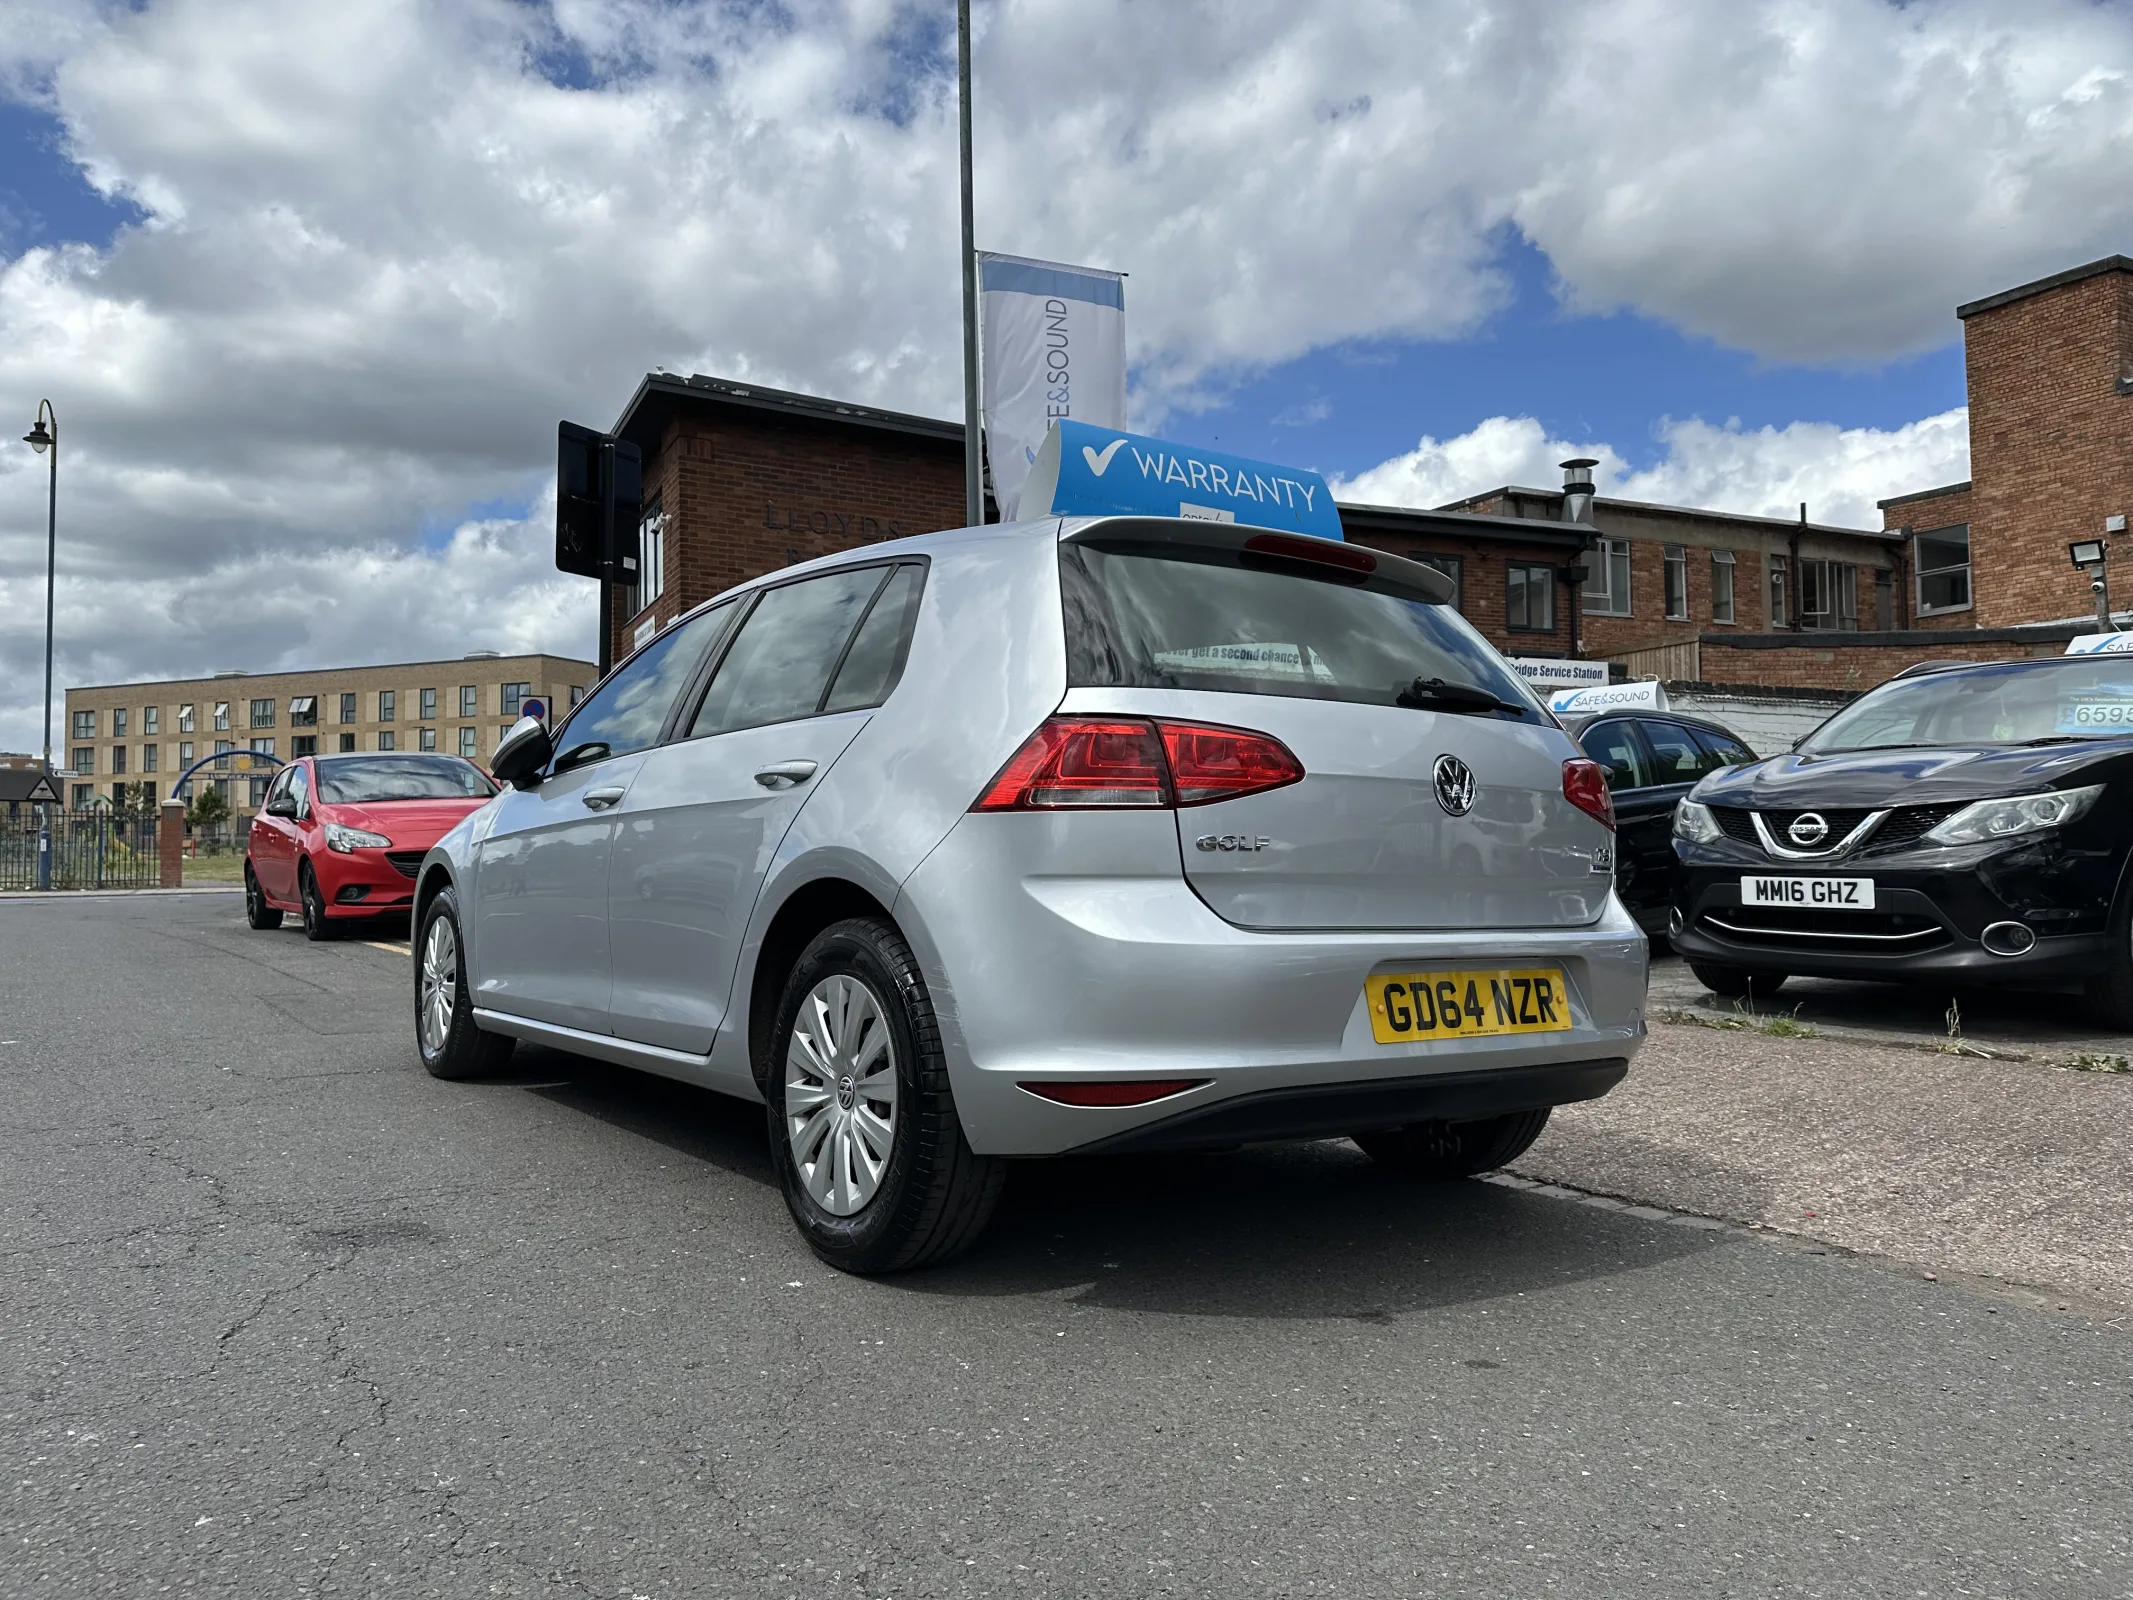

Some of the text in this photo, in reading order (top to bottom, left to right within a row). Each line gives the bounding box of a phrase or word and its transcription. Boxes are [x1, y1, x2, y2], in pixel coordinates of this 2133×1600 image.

[1046, 299, 1070, 432] E&SOUND
[1131, 447, 1315, 512] WARRANTY
[764, 503, 901, 540] LLOYDS
[1191, 646, 1210, 658] get
[1211, 647, 1219, 658] a
[1220, 647, 1260, 660] second
[1261, 650, 1299, 664] chance
[1511, 663, 1603, 679] ridge Service Station
[1575, 690, 1650, 707] SAFE&SOUND
[1196, 834, 1270, 852] GOLF
[1755, 879, 1859, 903] MM16 GHZ
[1383, 977, 1558, 1033] GD64 NZR
